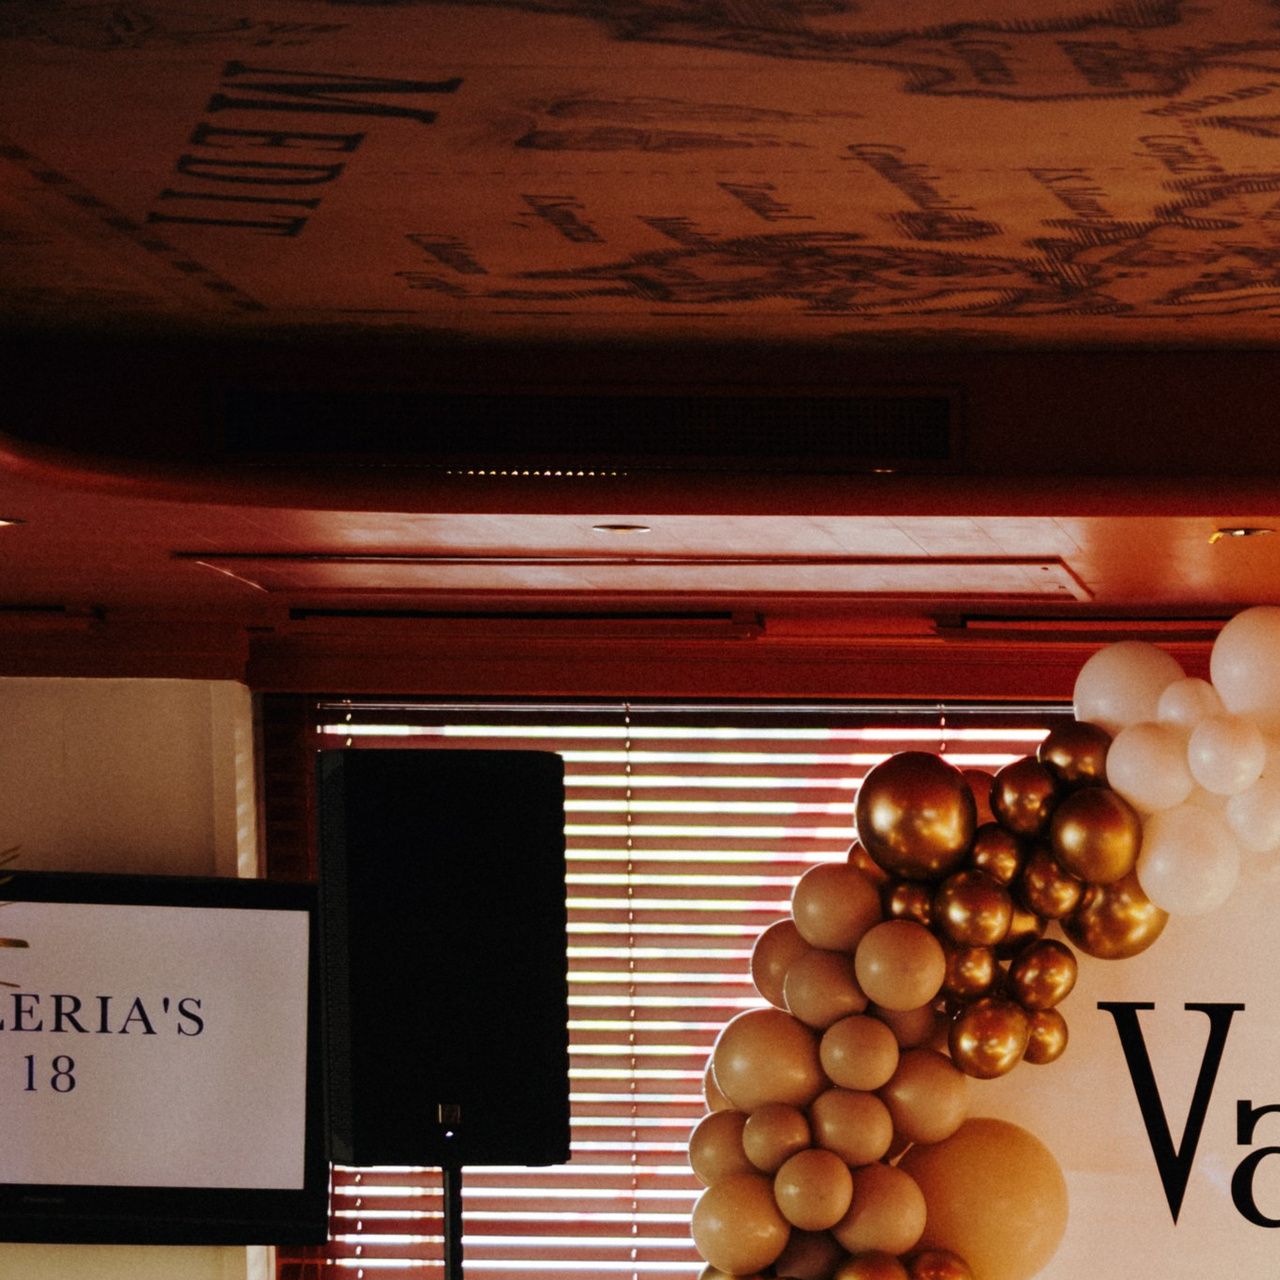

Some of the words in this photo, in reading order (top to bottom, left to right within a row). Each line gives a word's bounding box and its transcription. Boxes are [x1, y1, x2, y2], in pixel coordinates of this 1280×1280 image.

[145, 59, 466, 238] MEDIT
[0, 992, 205, 1037] ERIA'S
[23, 1053, 77, 1093] 18
